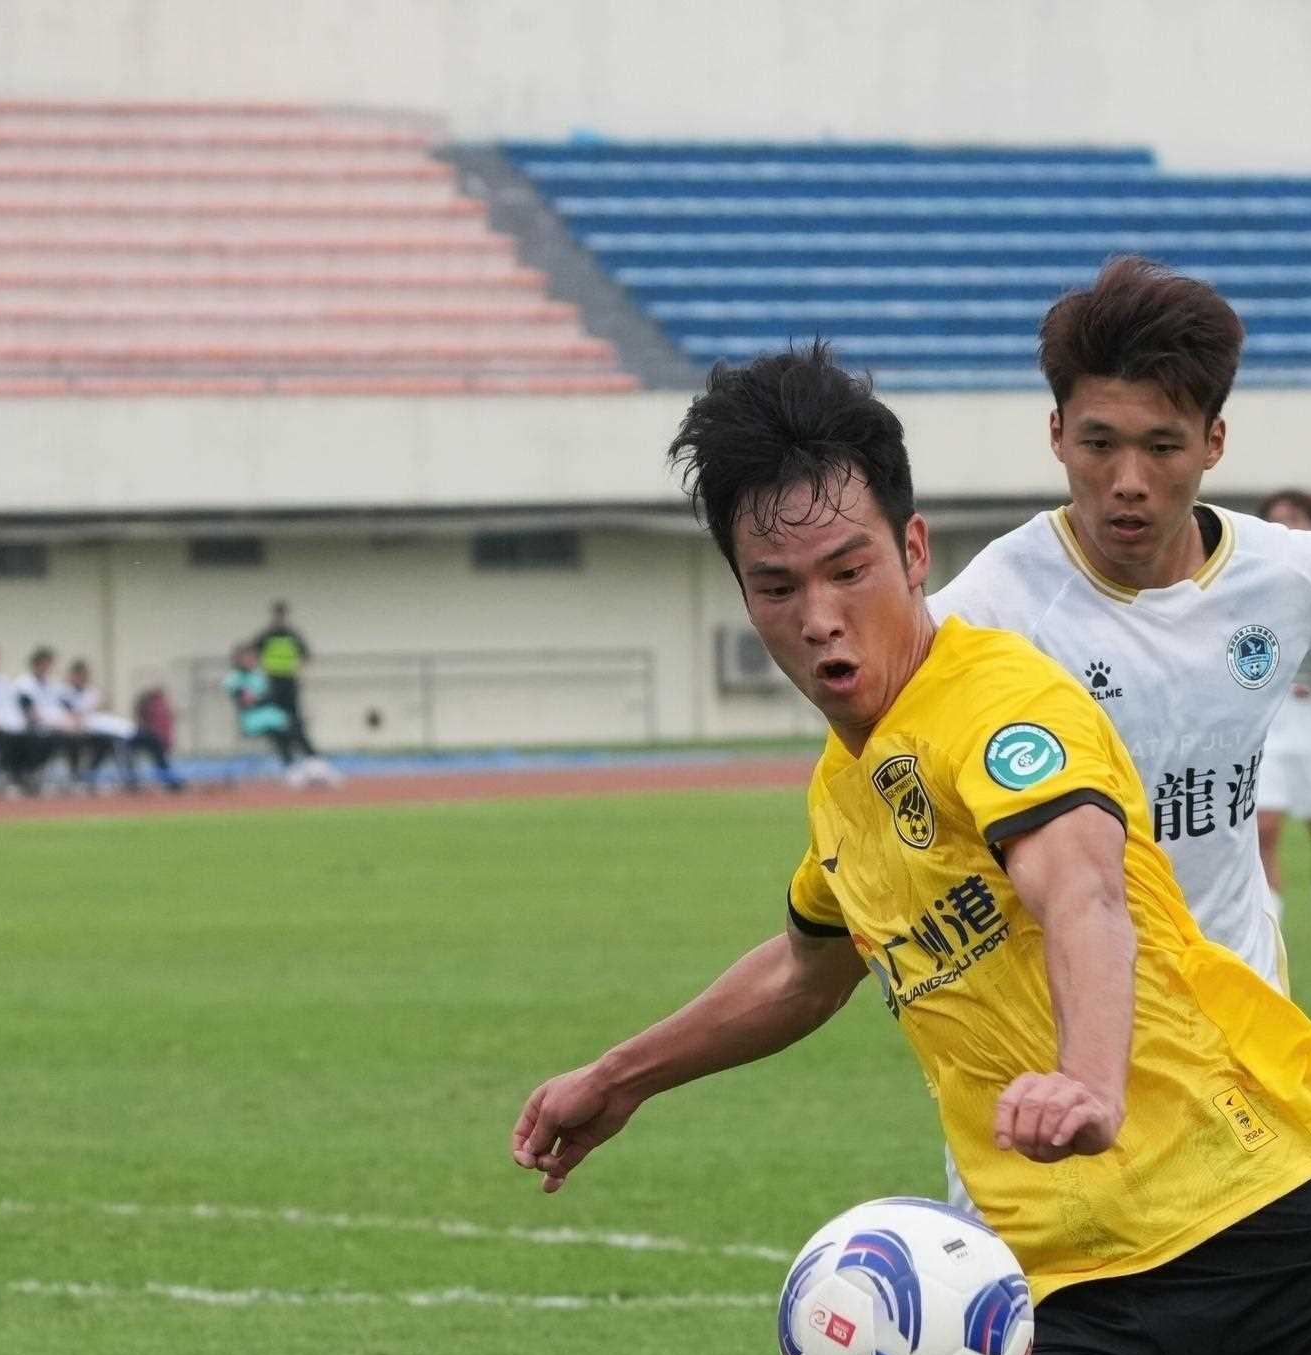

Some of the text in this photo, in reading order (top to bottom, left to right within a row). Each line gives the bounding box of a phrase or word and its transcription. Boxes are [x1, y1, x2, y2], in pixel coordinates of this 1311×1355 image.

[883, 874, 1004, 990] 广州港
[971, 922, 1010, 962] PORT
